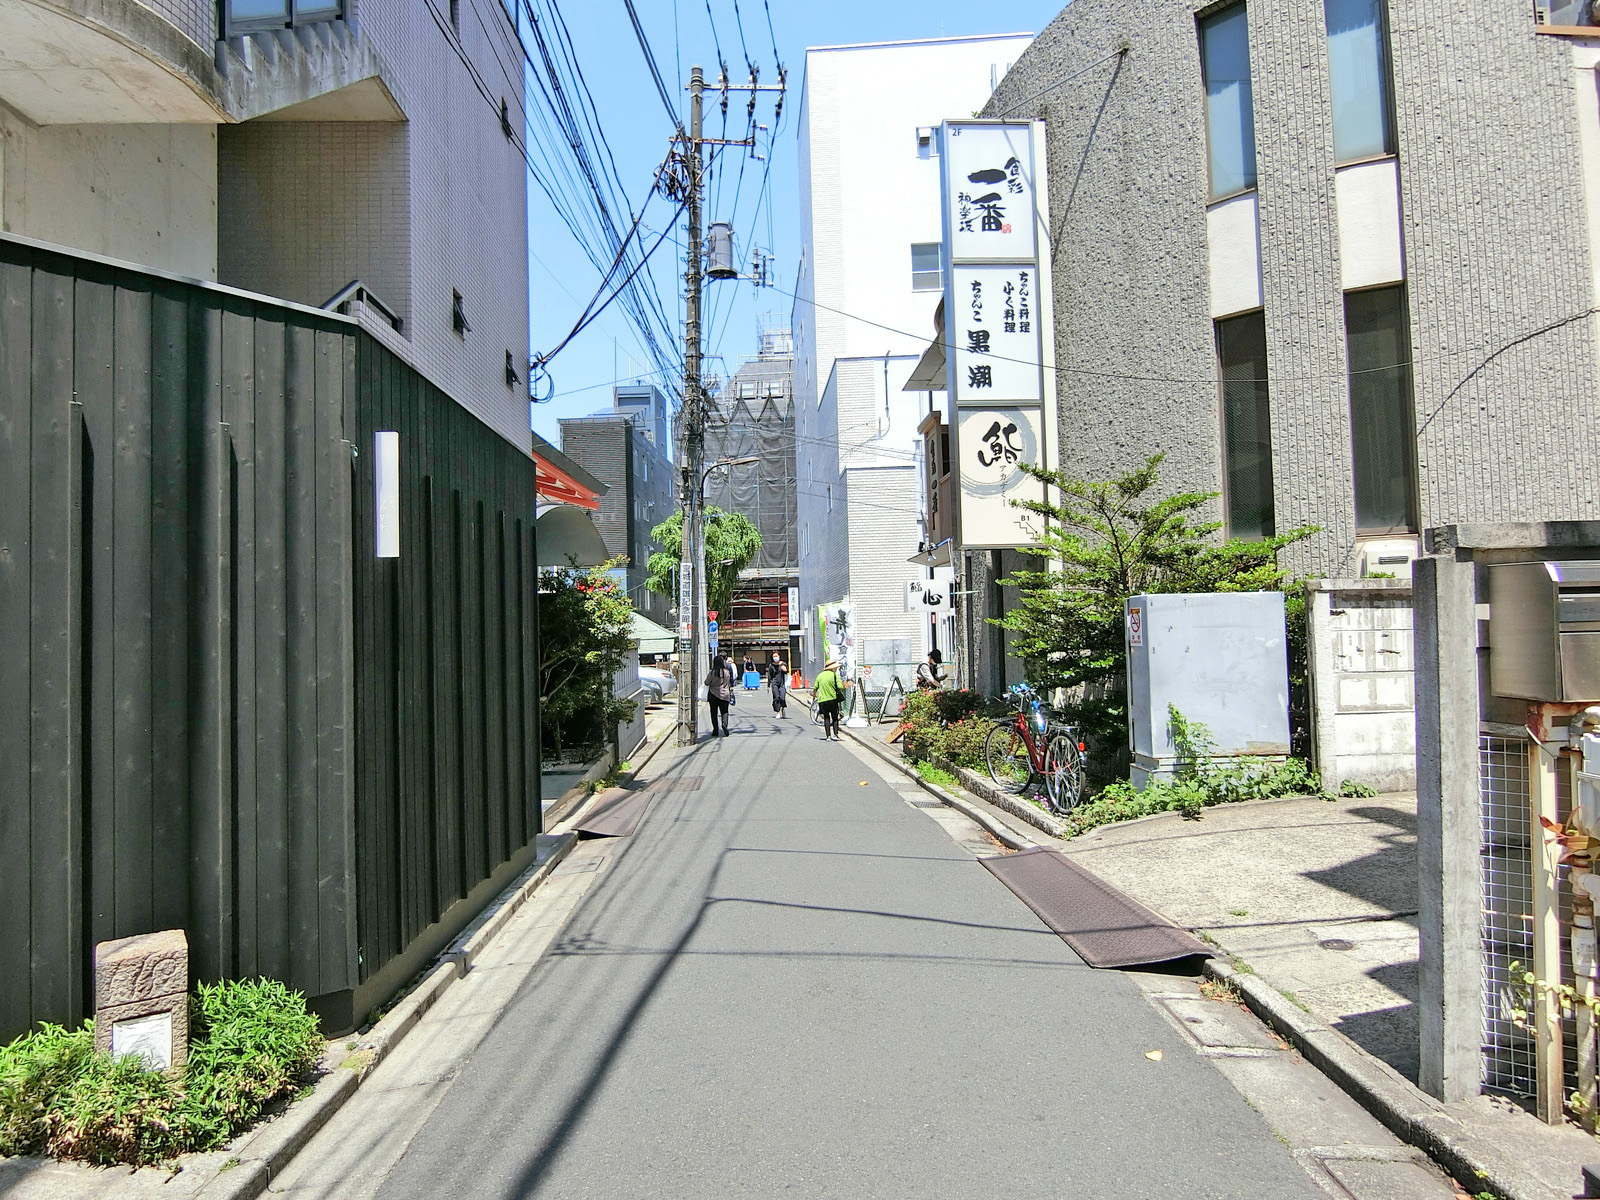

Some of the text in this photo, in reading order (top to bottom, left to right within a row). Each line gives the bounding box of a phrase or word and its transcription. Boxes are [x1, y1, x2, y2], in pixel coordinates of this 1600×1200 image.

[952, 128, 962, 136] 2F
[1004, 156, 1024, 194] 食彩
[958, 192, 975, 232] 神楽坂
[967, 168, 1007, 232] 一番
[1003, 281, 1016, 333] ふぐ料理
[1018, 271, 1030, 333] ちゃんこ料理
[966, 280, 993, 389] ちゃんこ 黒潮
[977, 421, 1023, 467] 鮨
[922, 588, 943, 606] 心
